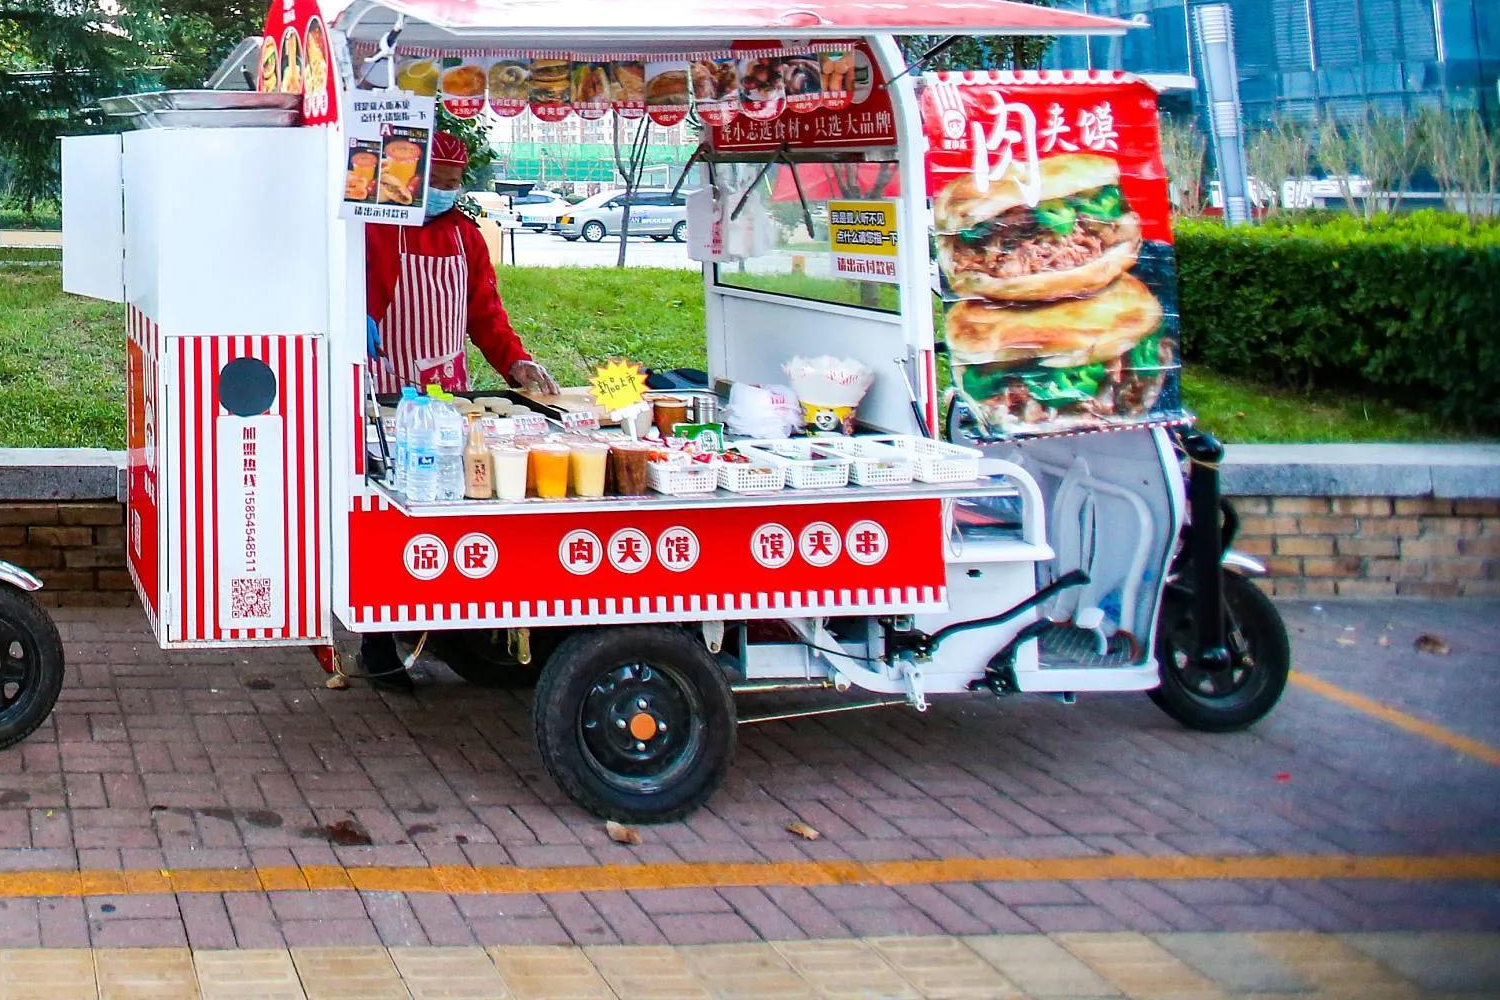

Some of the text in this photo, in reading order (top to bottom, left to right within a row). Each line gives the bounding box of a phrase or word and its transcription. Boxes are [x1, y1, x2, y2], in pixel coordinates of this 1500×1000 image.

[380, 124, 392, 137] A
[836, 256, 896, 277] 请出示付款码
[596, 374, 638, 399] 新品上市
[242, 426, 257, 573] 加盟热线 15854548511
[410, 527, 882, 573] 凉皮 肉夹馍 馍夹串
